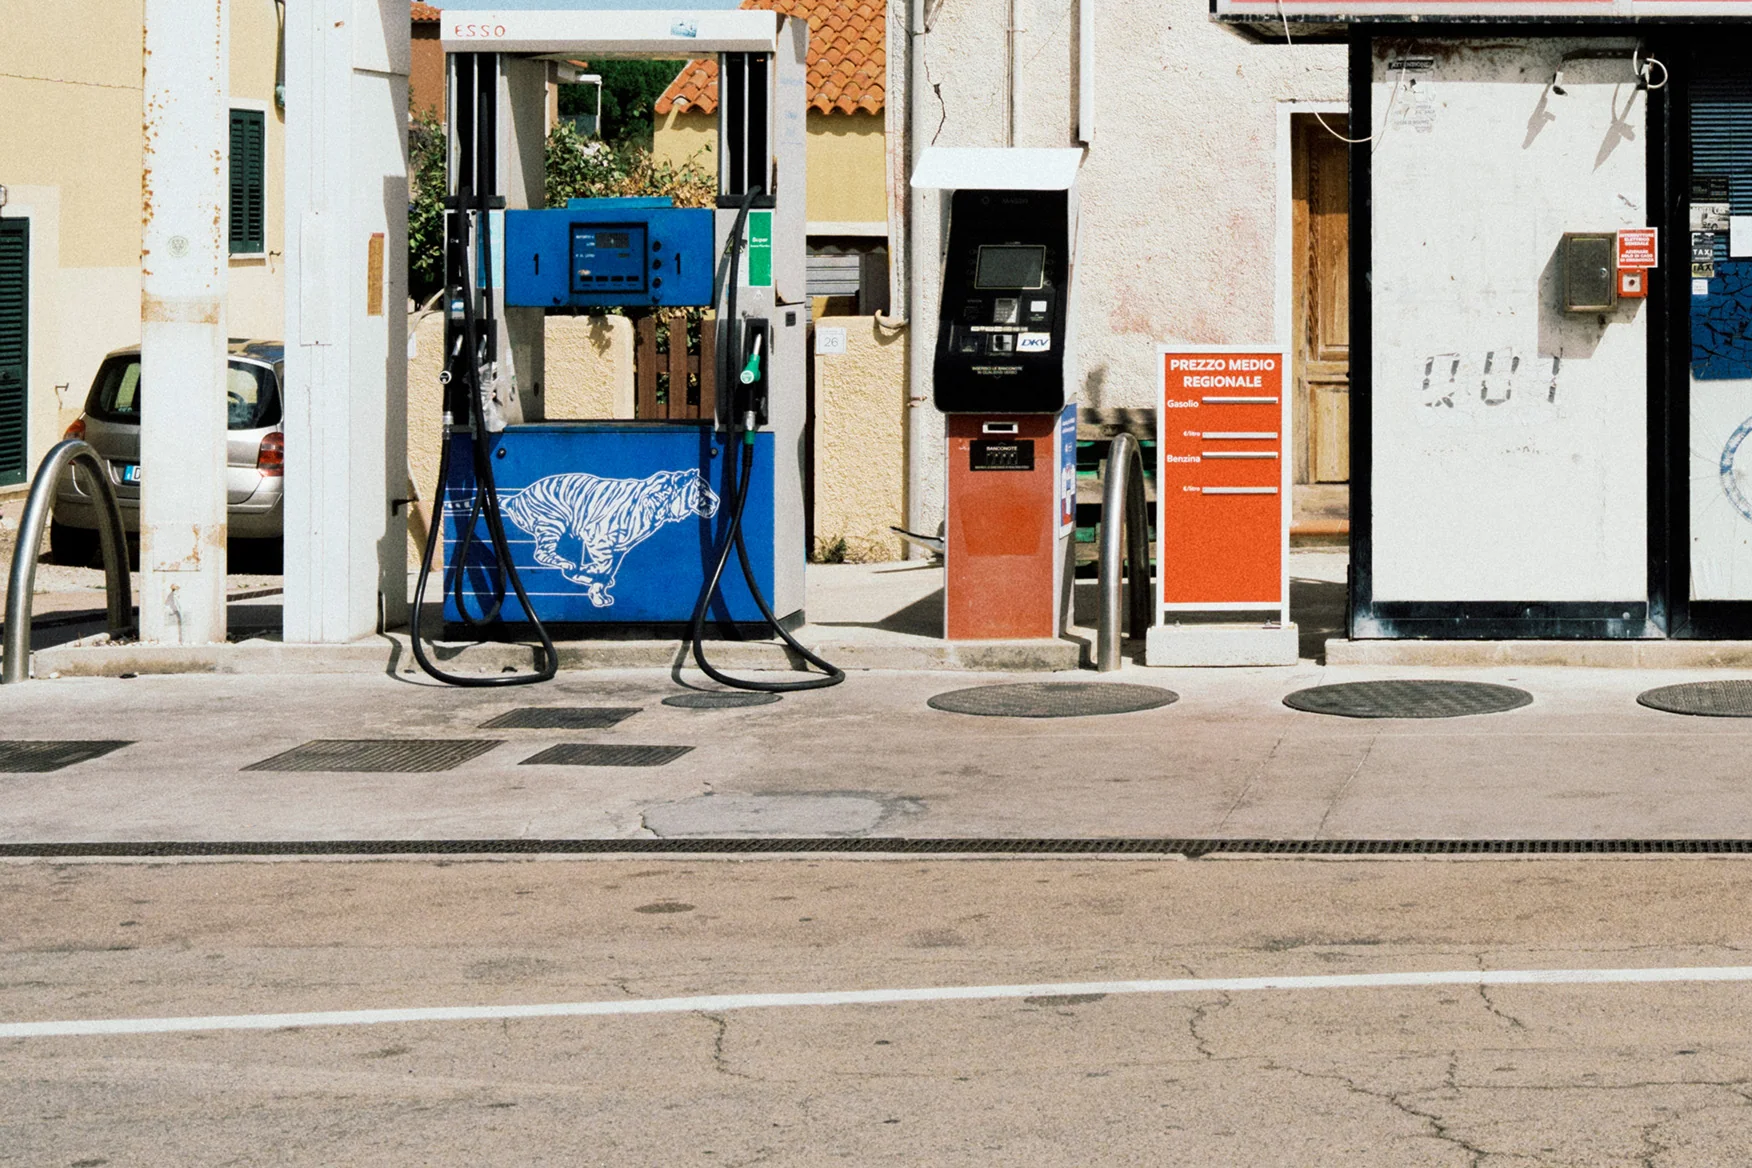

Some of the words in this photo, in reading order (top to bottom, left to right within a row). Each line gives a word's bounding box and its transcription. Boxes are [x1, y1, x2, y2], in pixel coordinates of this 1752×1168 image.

[455, 24, 506, 38] ESSO
[1693, 248, 1713, 256] TAXI
[533, 254, 539, 275] 1
[675, 254, 680, 274] 1
[824, 337, 839, 348] 26
[1170, 359, 1226, 371] PREZZO
[1229, 359, 1275, 371] MEDIO
[1183, 376, 1262, 387] REGIONALE
[1167, 400, 1199, 408] Gasolio
[1167, 455, 1201, 463] Benzina
